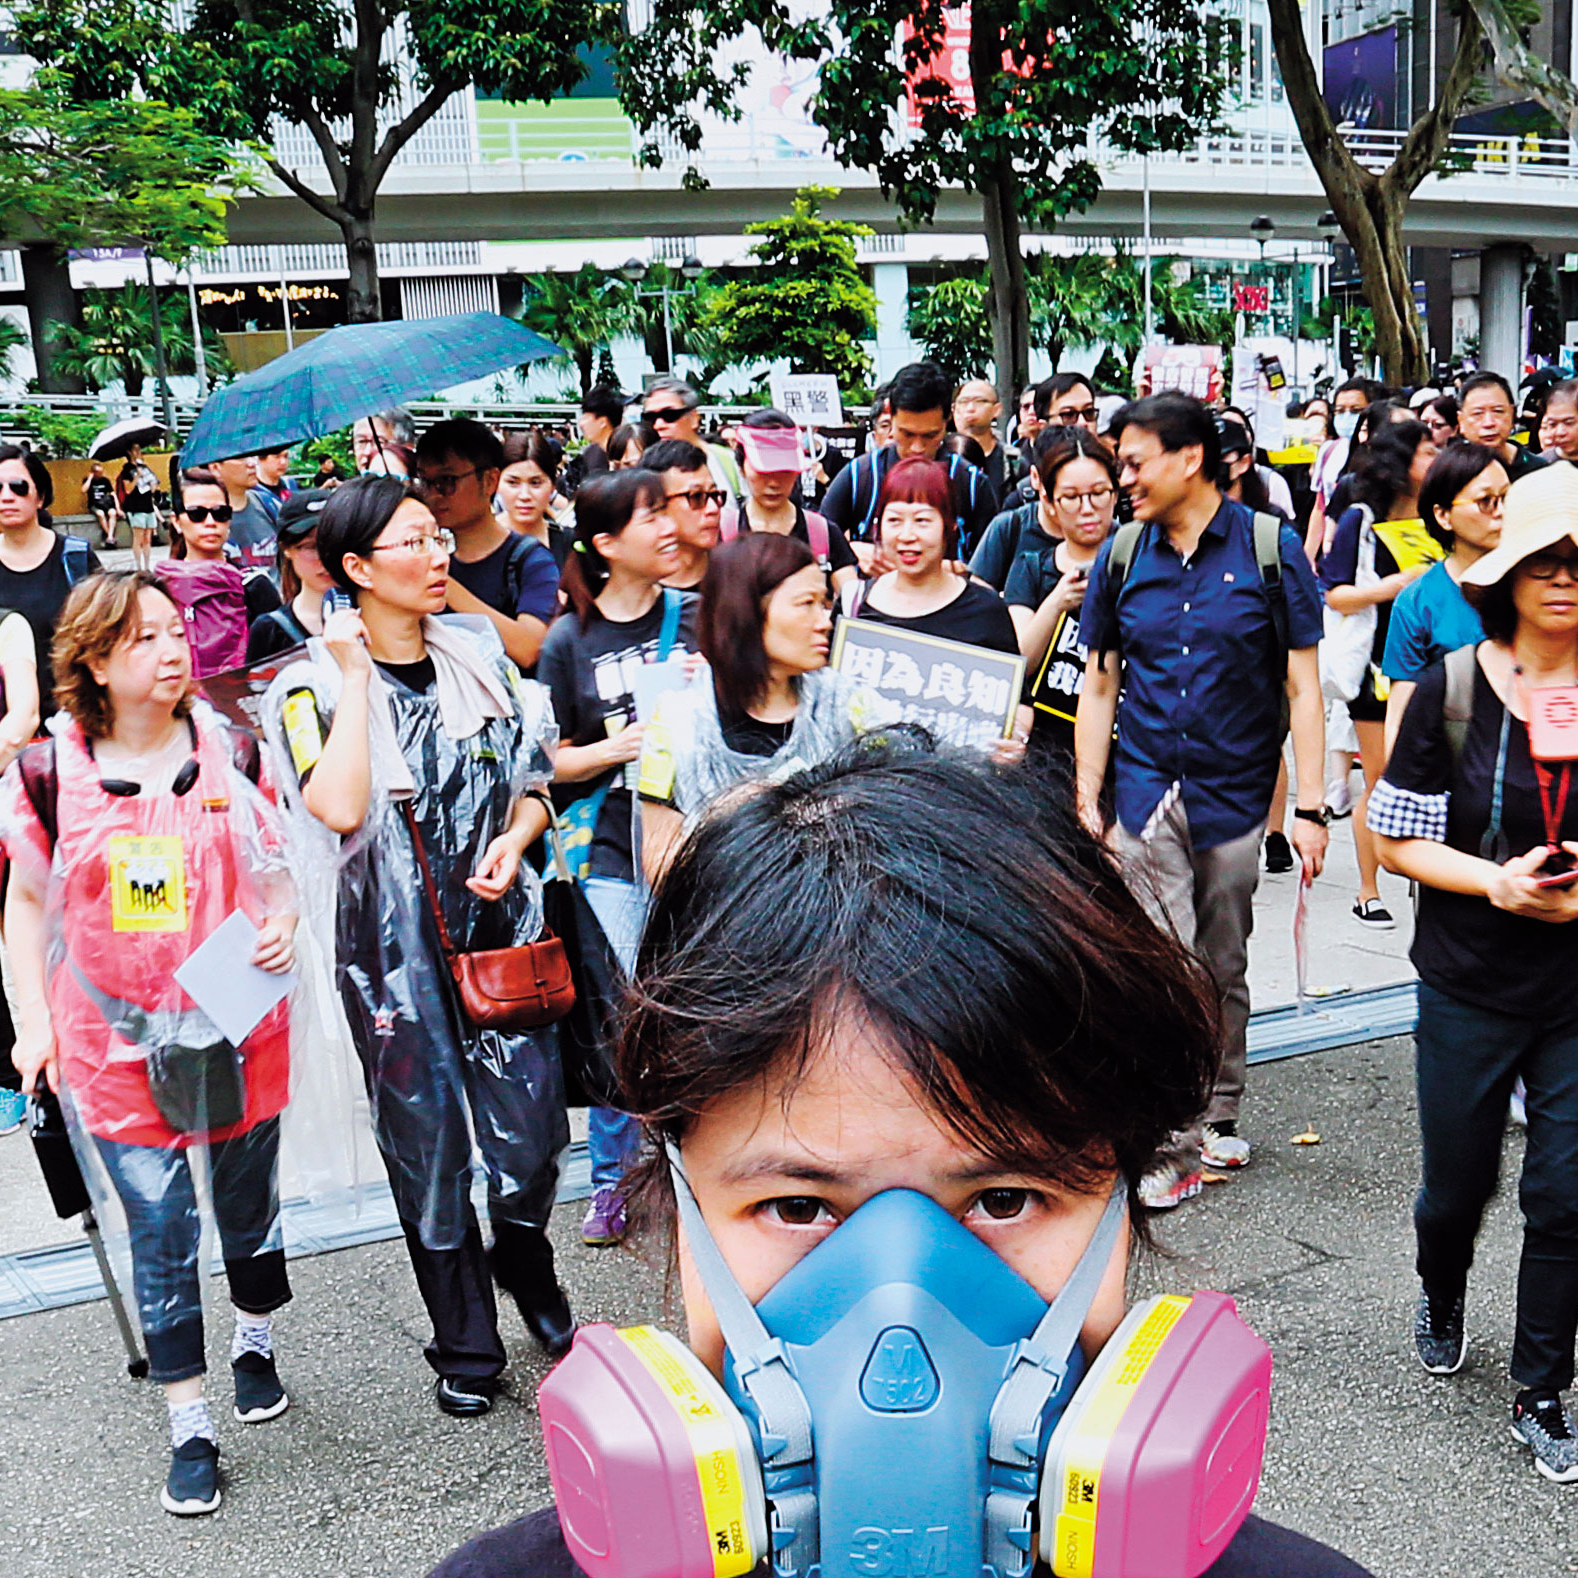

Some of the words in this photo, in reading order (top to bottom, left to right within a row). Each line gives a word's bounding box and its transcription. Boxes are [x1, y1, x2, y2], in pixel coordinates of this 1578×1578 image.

[1082, 1480, 1096, 1503] 3M
[715, 1530, 730, 1555] 3M
[848, 1525, 950, 1578] 3M
[1066, 1530, 1079, 1571] NIOSH
